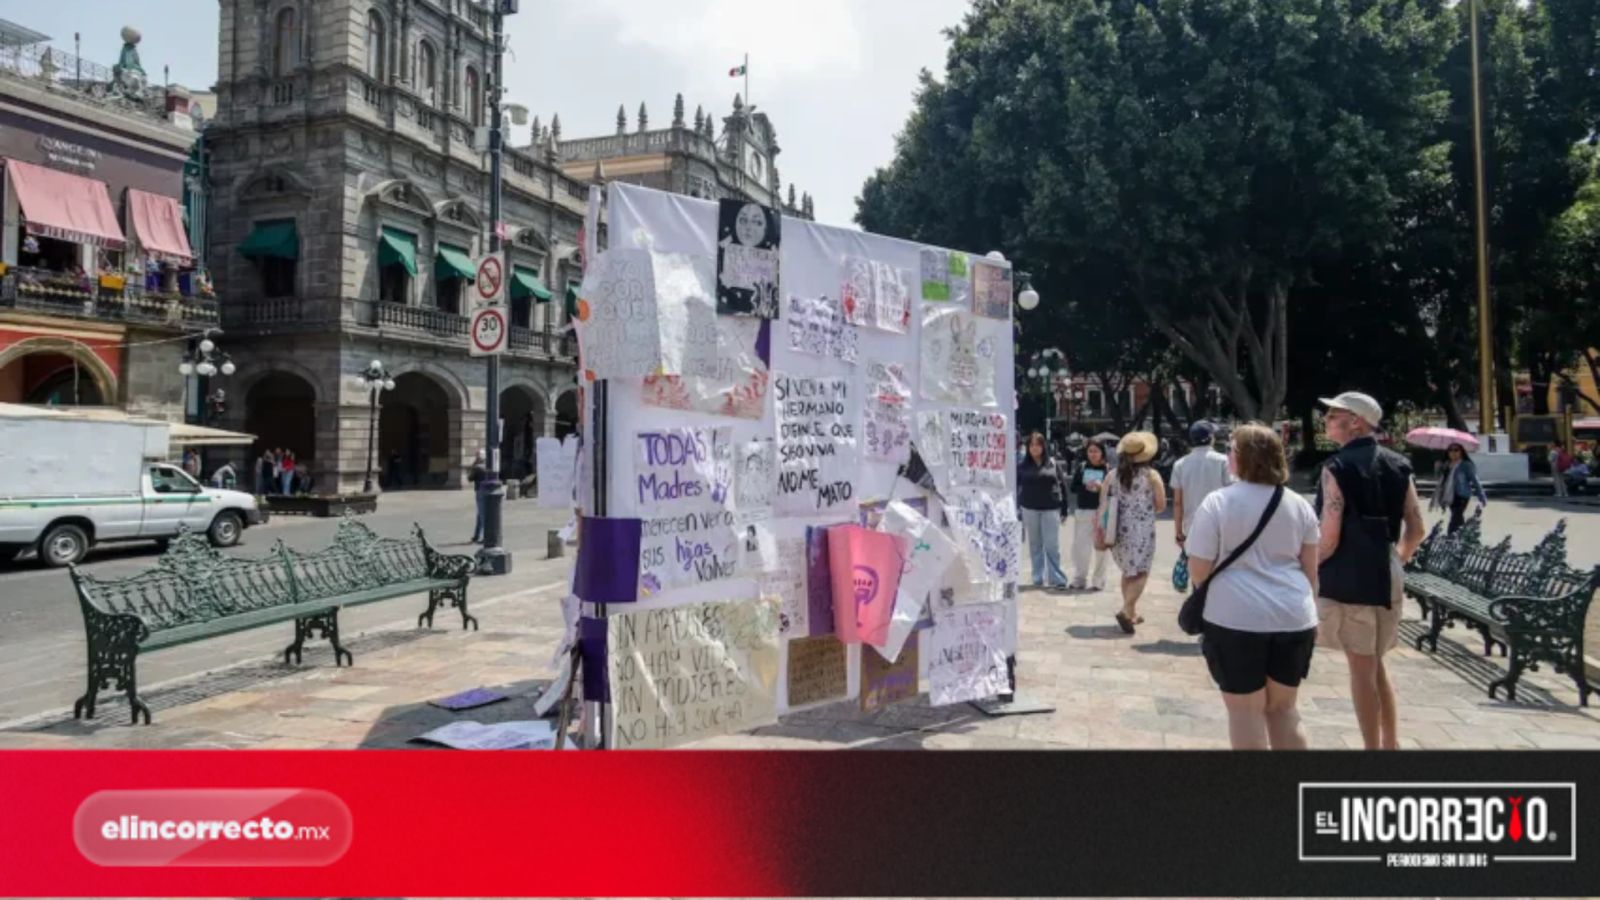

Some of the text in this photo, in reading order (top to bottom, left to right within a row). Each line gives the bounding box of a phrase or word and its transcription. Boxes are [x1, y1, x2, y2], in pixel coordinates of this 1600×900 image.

[481, 316, 497, 332] 30
[782, 401, 845, 419] HERMANO
[637, 431, 707, 466] TODAS
[638, 469, 703, 504] Madres
[816, 480, 853, 509] MATO
[617, 719, 648, 746] NO
[655, 714, 687, 737] HY
